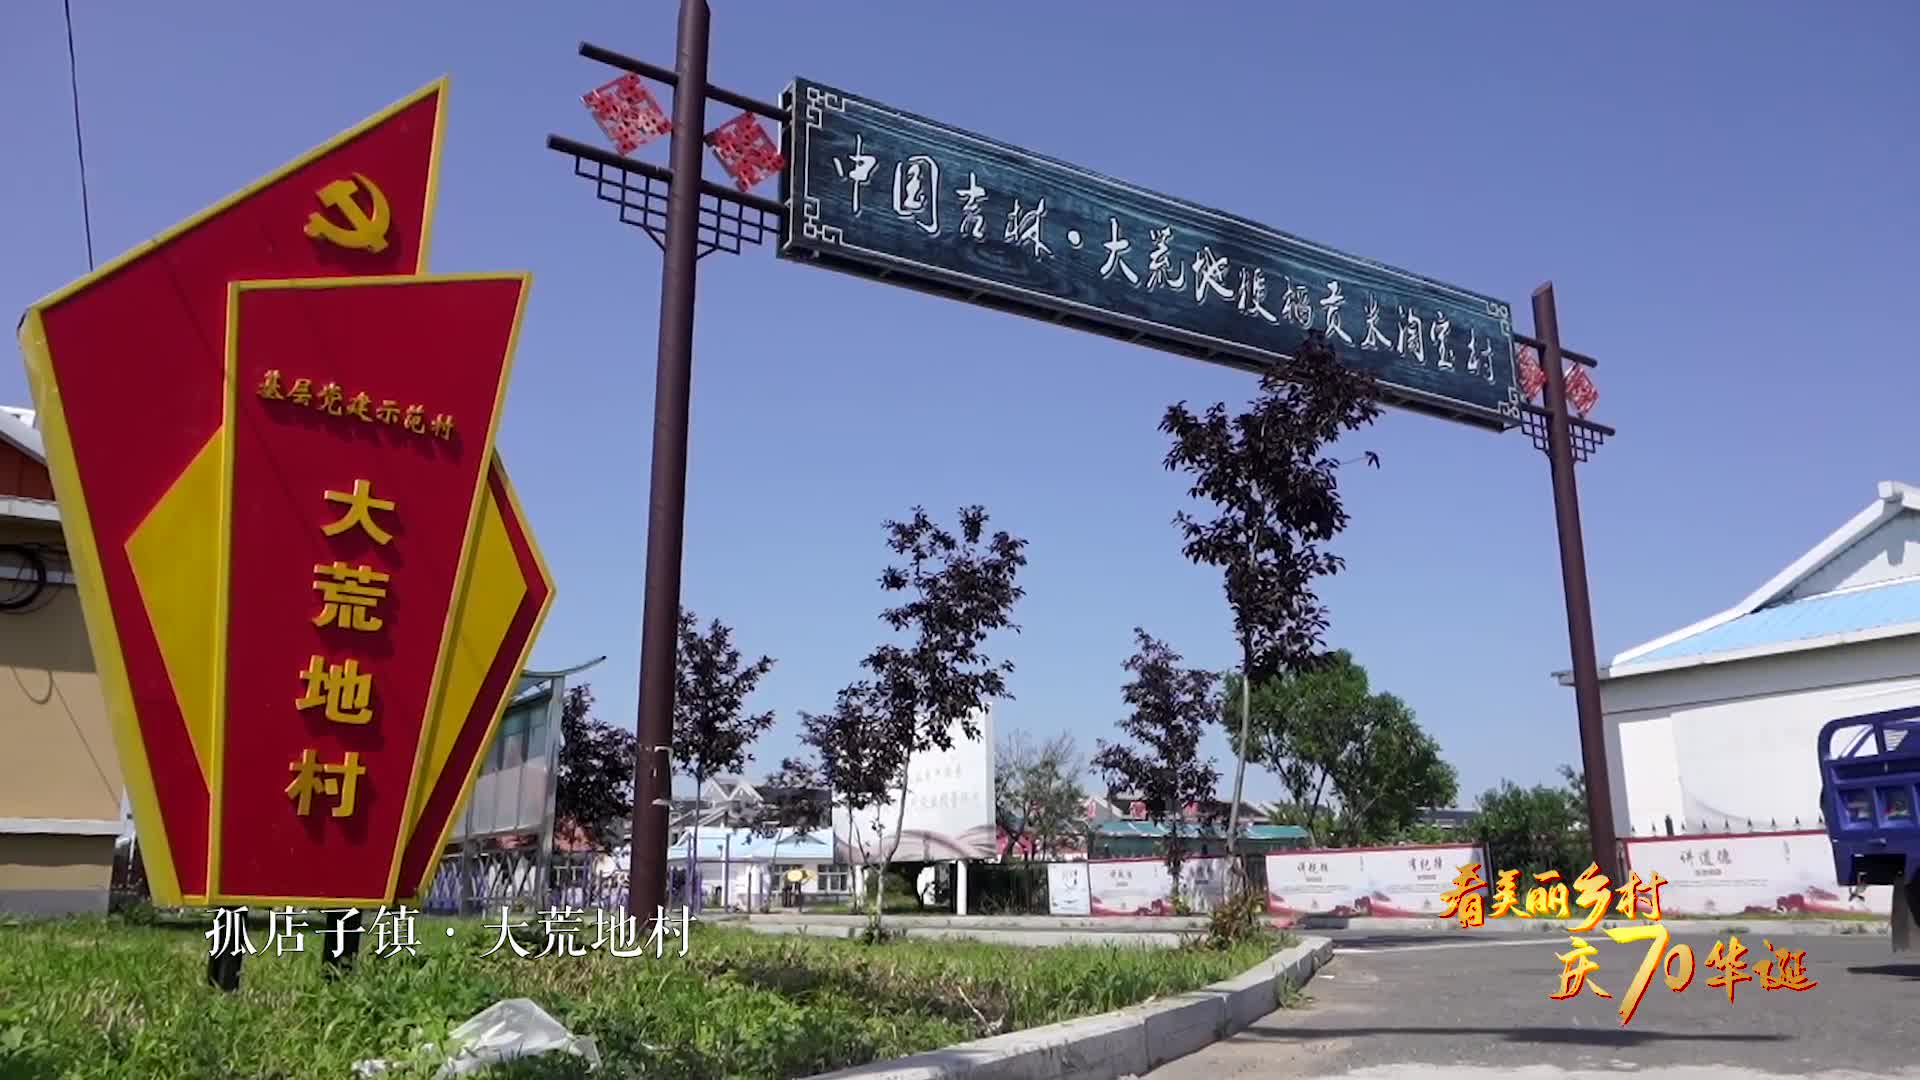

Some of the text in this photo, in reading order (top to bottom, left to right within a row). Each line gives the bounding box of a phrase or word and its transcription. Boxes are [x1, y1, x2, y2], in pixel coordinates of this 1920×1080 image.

[256, 369, 454, 441] 基层党建示范村
[285, 479, 396, 818] 大荒地村
